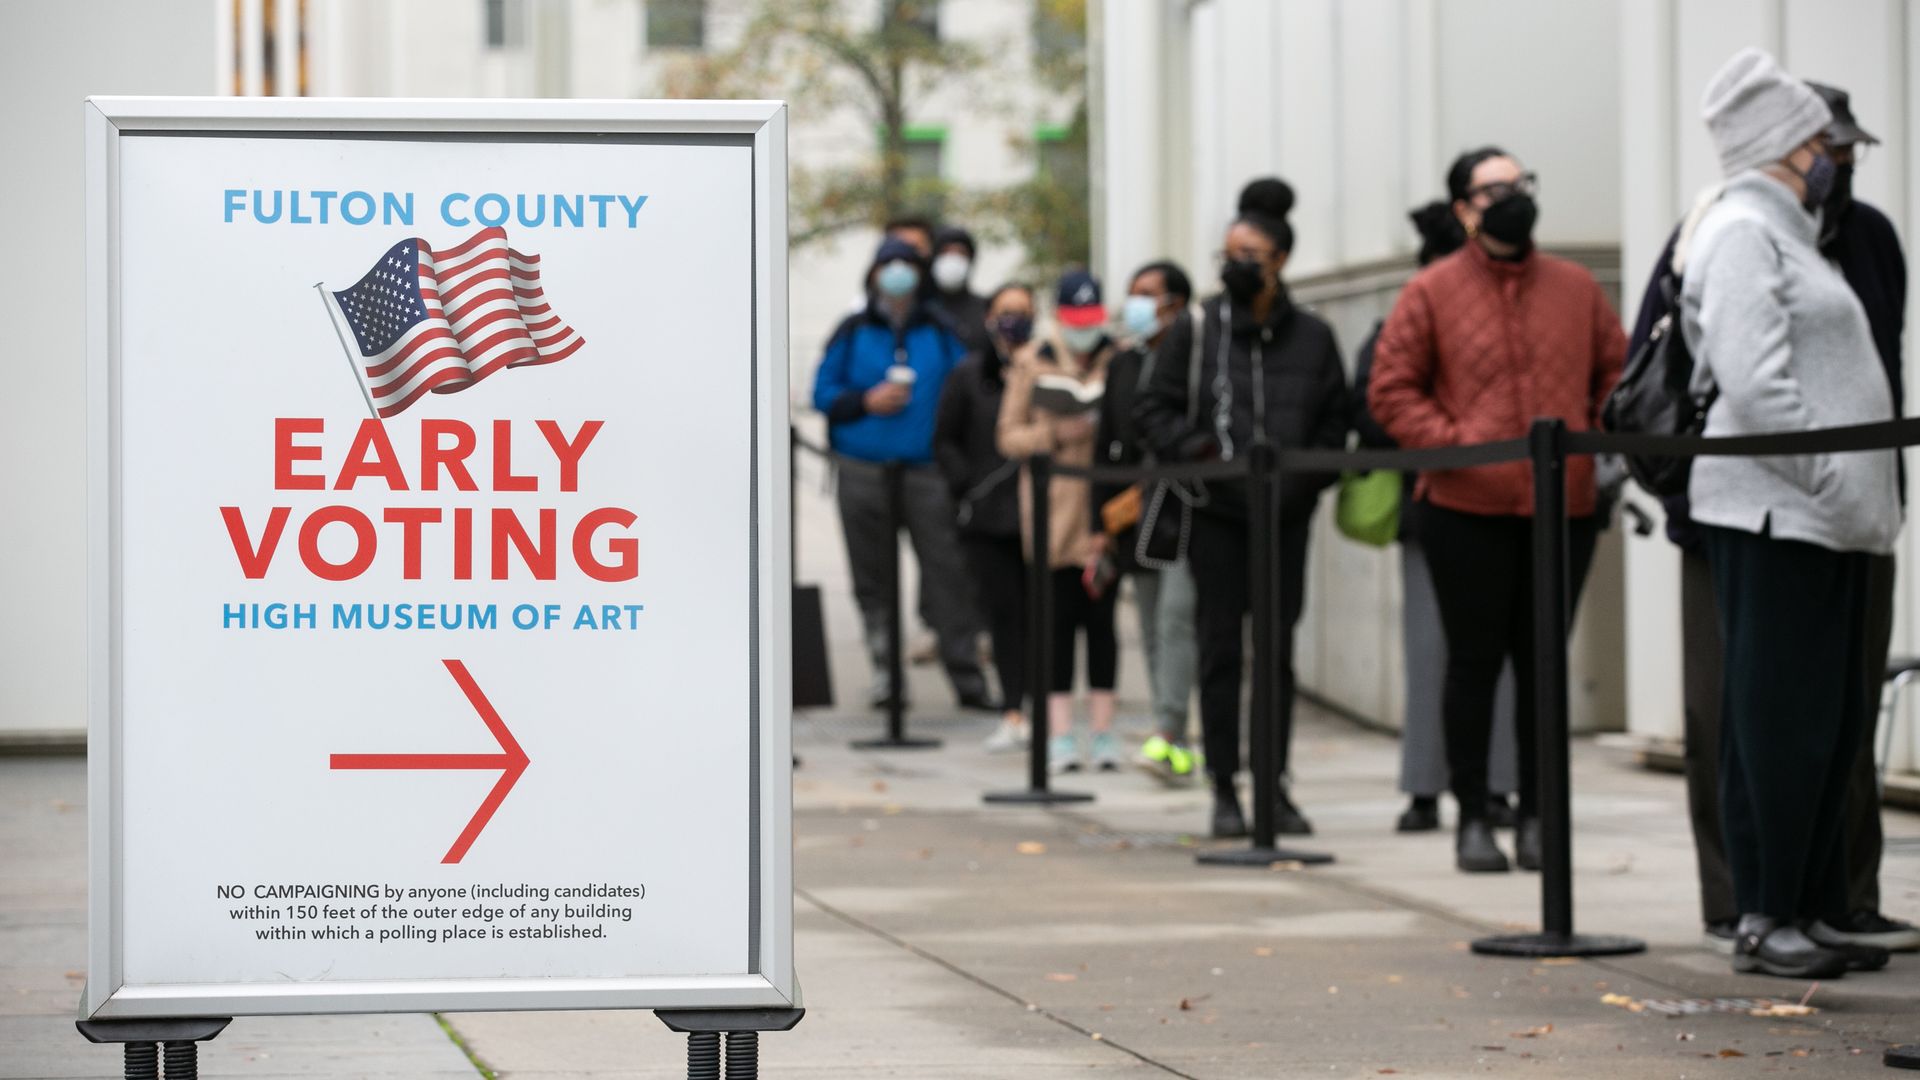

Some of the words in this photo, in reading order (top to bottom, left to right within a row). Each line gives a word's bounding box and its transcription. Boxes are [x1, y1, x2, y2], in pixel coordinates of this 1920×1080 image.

[223, 189, 415, 226] FULTON
[440, 192, 649, 228] COUNTY
[274, 417, 605, 493] EARLY
[219, 504, 639, 583] VOTING
[223, 602, 317, 630] HIGH
[332, 603, 497, 631] MUSEUM
[511, 603, 561, 631] OF
[572, 604, 644, 631] ART
[216, 884, 246, 900] NO
[253, 884, 380, 900] CAMPAIGNING
[384, 883, 405, 903] by
[407, 887, 467, 903] anyone
[470, 882, 550, 902] (including
[553, 882, 646, 901] candidates)
[229, 904, 281, 920] within
[286, 905, 318, 920] 150
[322, 904, 356, 920] feet
[360, 903, 378, 919] of
[381, 903, 409, 919] the
[413, 905, 458, 919] outer
[461, 903, 505, 923] edge
[509, 903, 527, 919] of
[530, 908, 560, 923] any
[564, 903, 632, 922] building
[255, 924, 307, 940] within
[311, 924, 360, 940] which
[364, 929, 375, 940] a
[379, 924, 437, 944] polling
[442, 924, 487, 944] place
[491, 924, 504, 939] is
[508, 923, 607, 939] established.
